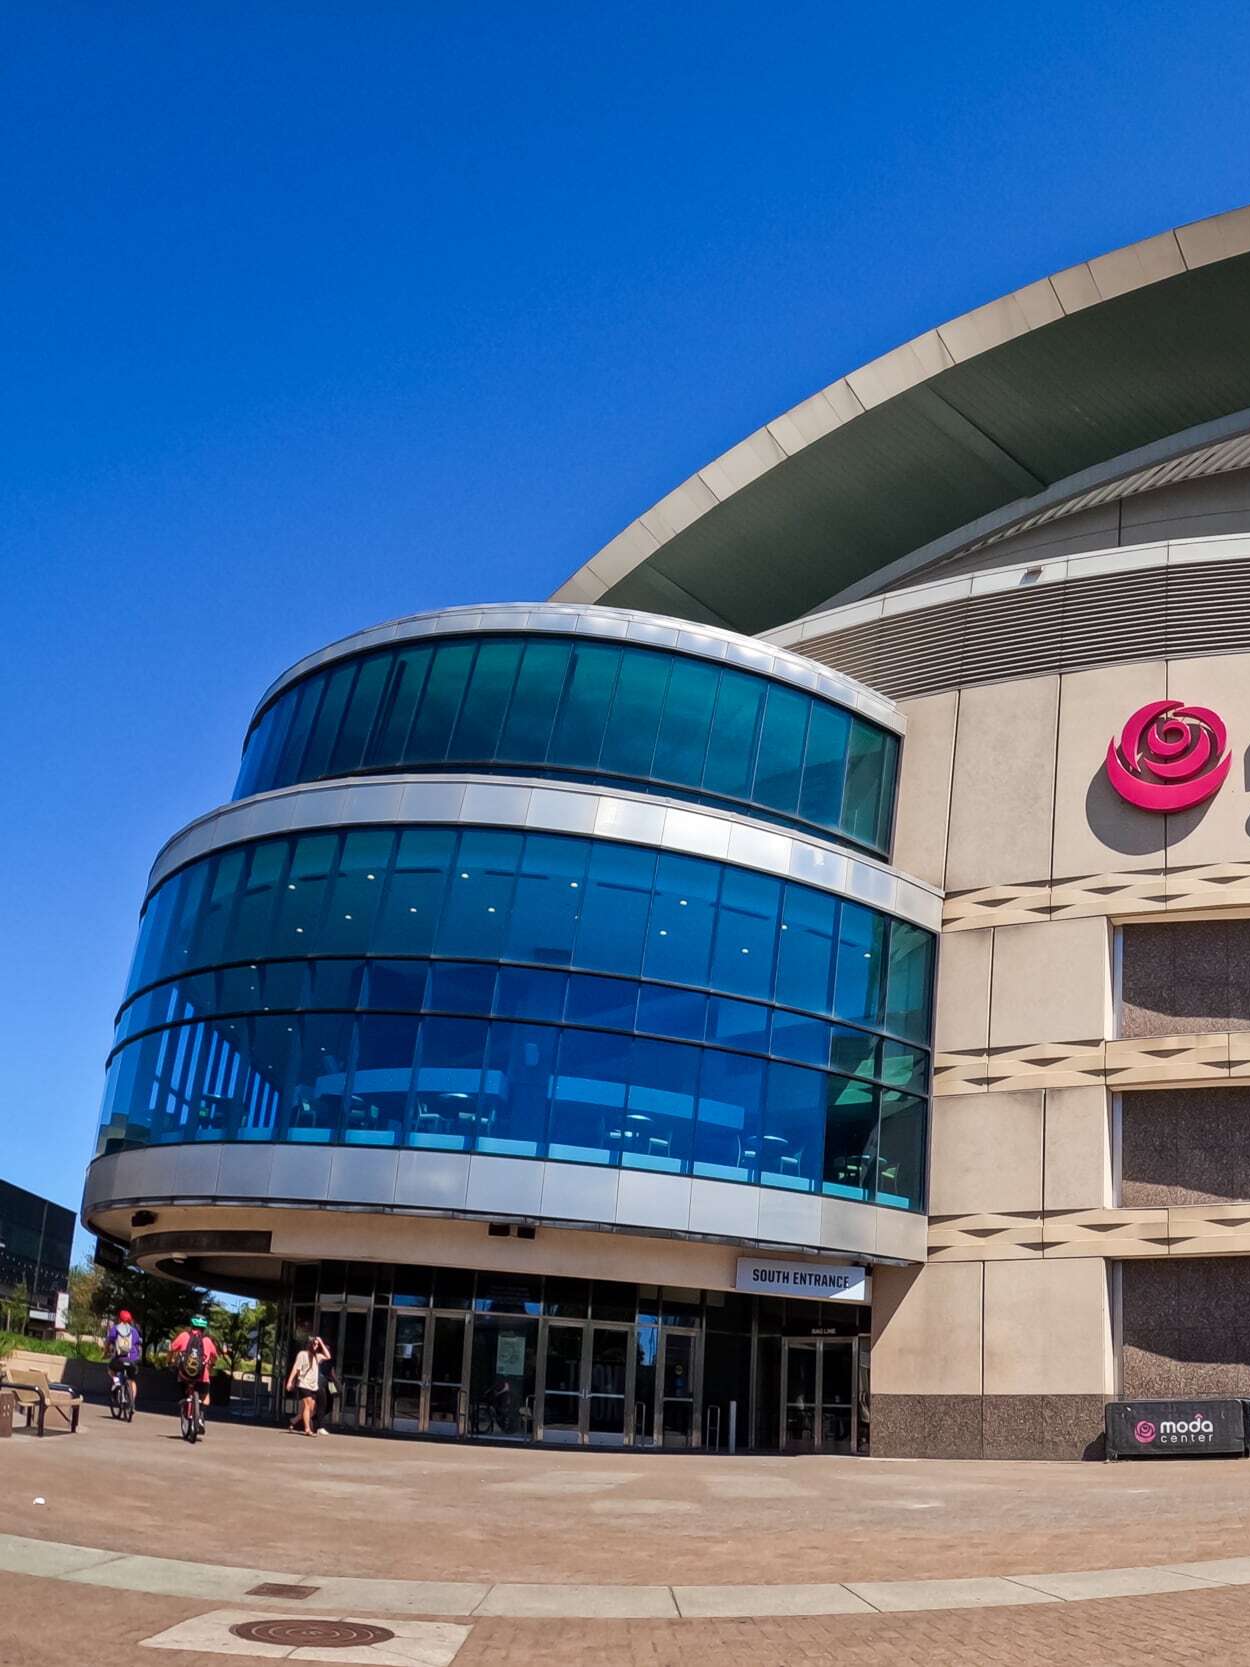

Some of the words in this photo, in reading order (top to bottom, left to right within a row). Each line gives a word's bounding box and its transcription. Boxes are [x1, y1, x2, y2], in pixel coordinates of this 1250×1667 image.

[752, 1268, 790, 1284] SOUTH
[793, 1271, 850, 1289] ENTRANCE
[1160, 1416, 1214, 1433] moda
[1160, 1433, 1214, 1443] center
